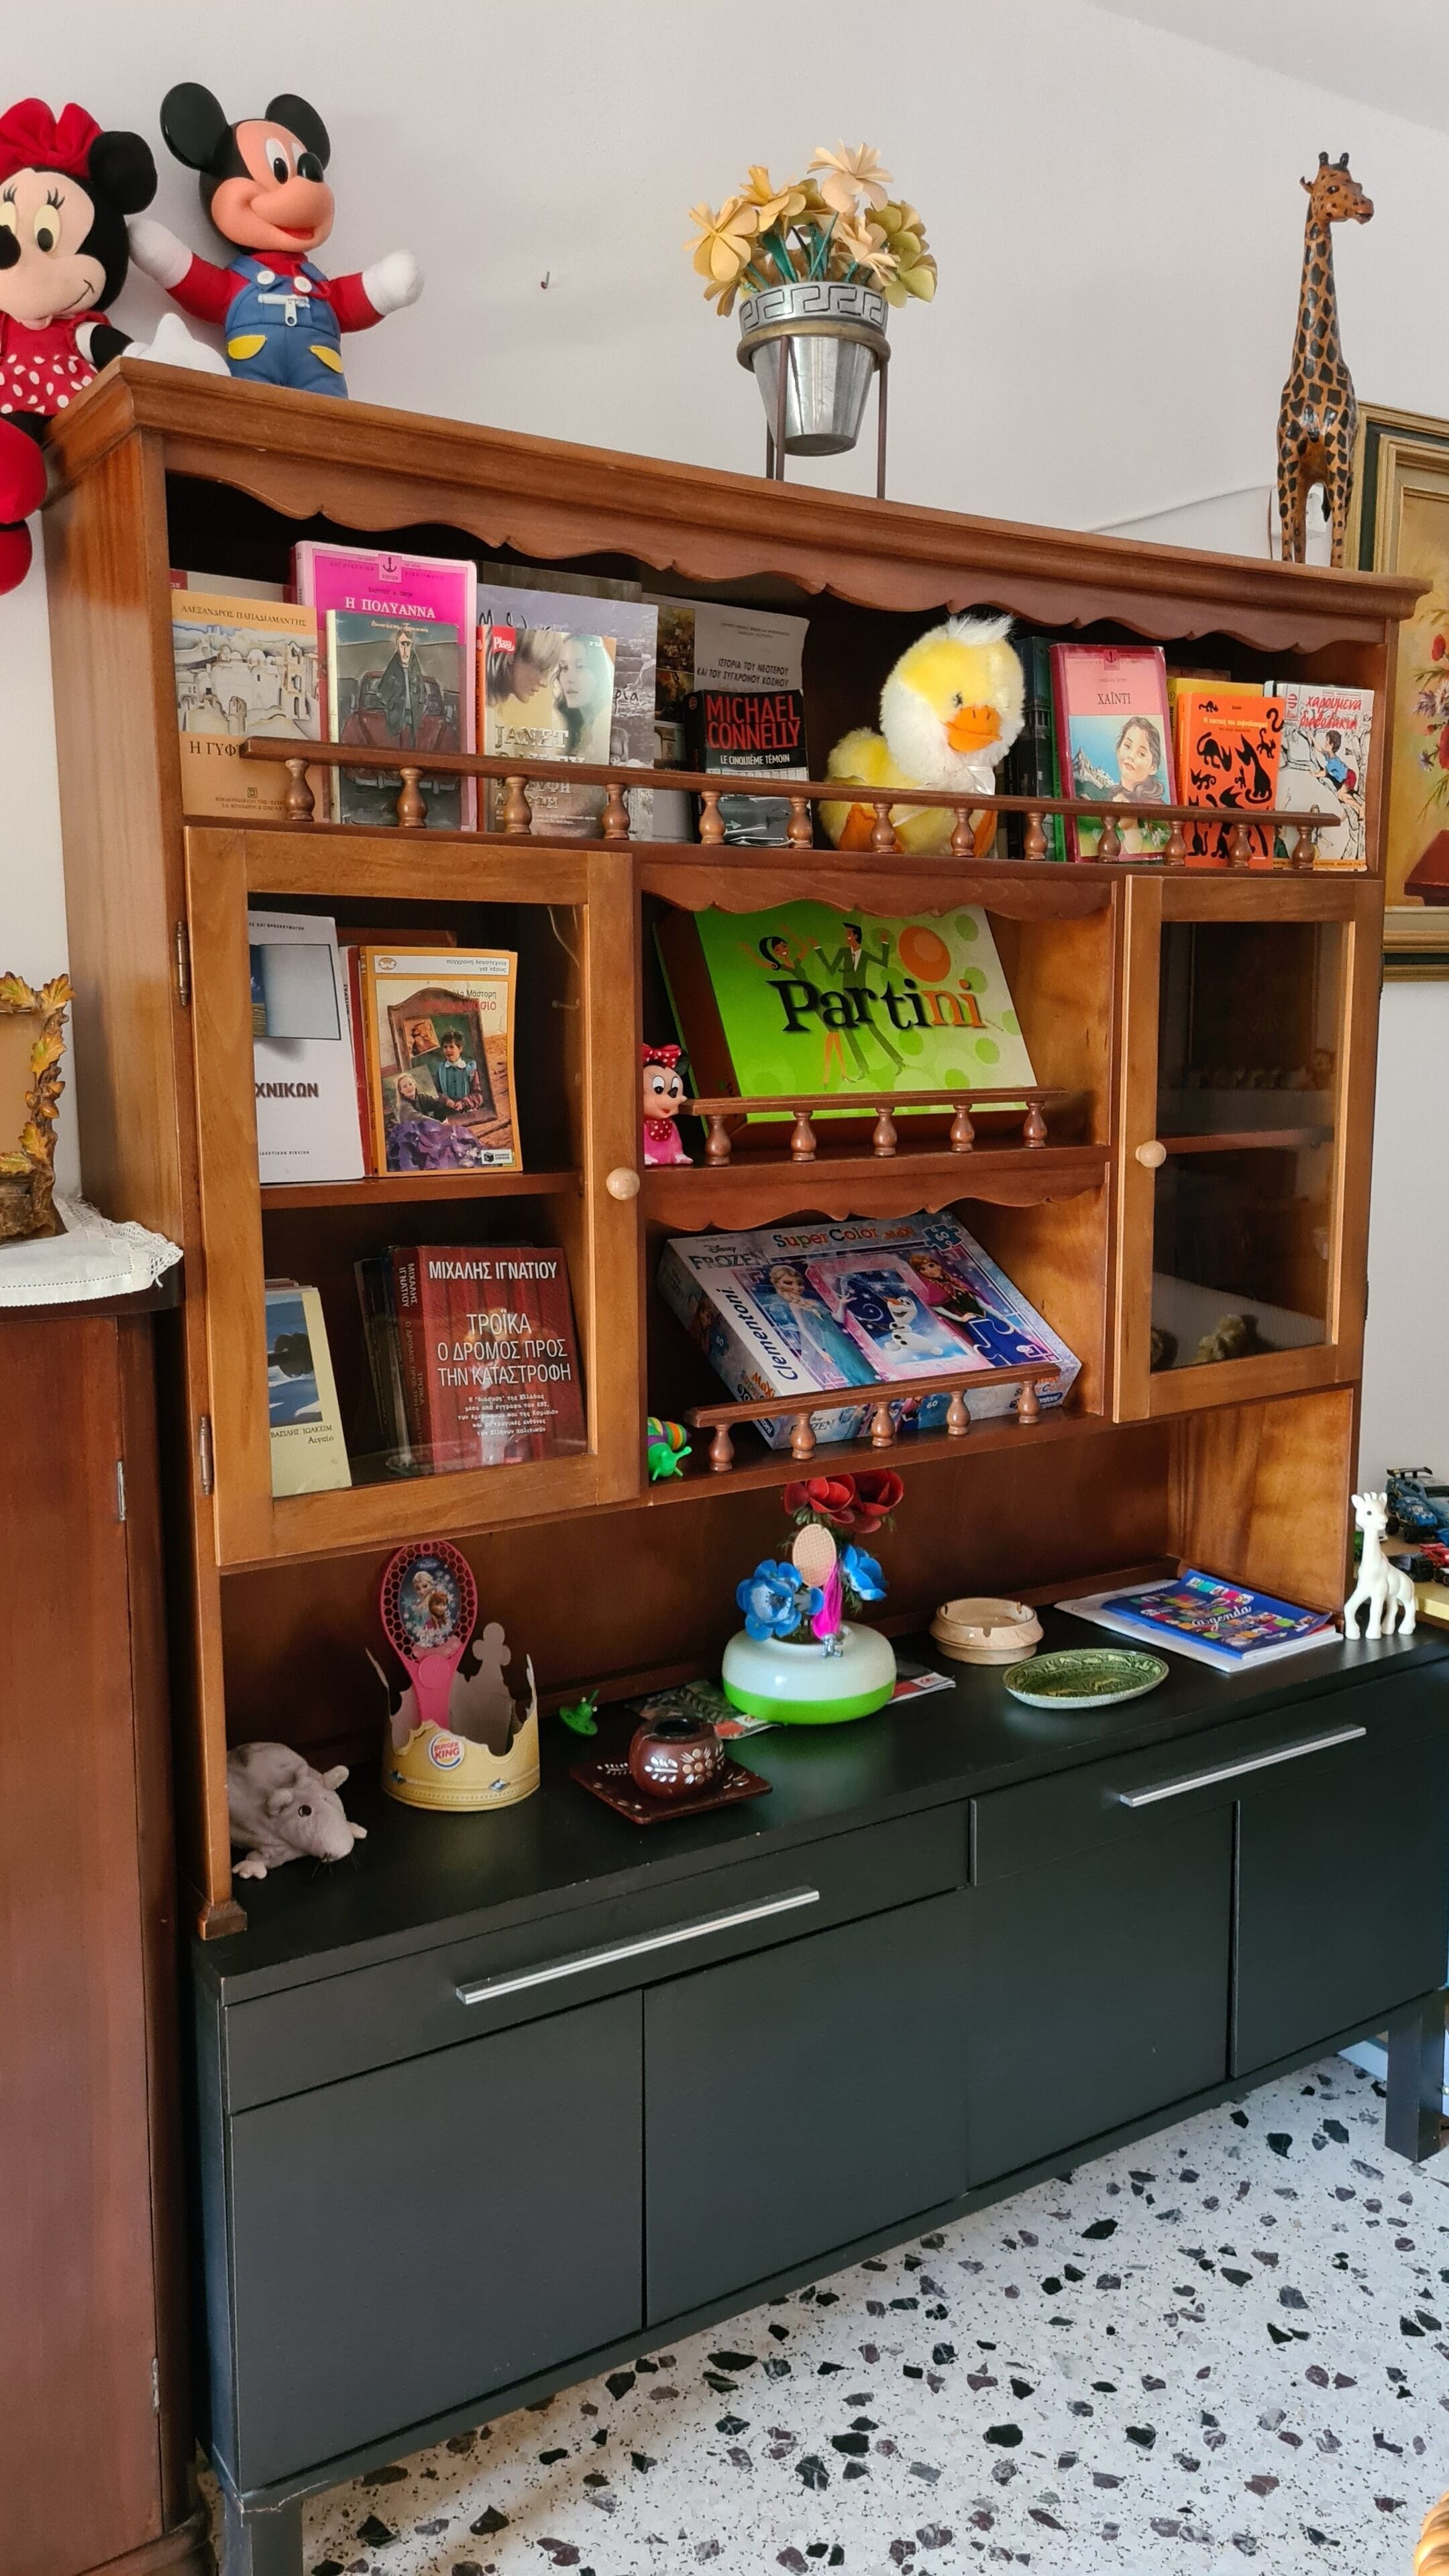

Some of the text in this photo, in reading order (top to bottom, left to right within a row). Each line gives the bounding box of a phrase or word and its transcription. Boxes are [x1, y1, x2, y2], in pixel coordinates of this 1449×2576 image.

[181, 605, 307, 627] ΑΛΕΞΑΝΔΡΟΣ ΠΑΠΑΔΙΑΜΑΝΤΗΣ
[345, 596, 436, 619] Η ΠΟΛΥΑΝΝΑ
[493, 636, 515, 652] Plaza
[696, 667, 708, 677] ΚΑΙ
[709, 668, 721, 679] ΤΟΥ
[722, 670, 761, 684] ΣΥΓΧΡΟΝΟΥ
[761, 676, 790, 688] ΚΟΣΜΟΥ
[718, 658, 789, 676] ΙΣΤΟΡΙΑ ΤΟΥ ΝΕΟΤΕΡΟΥ
[705, 694, 801, 724] MICHAEL
[1097, 692, 1132, 705] ΧΑΪΝΤΙ
[494, 724, 570, 749] JANET
[706, 720, 801, 750] CONNELLY
[189, 741, 240, 757] Η ΓΥΦ
[720, 755, 728, 765] LE
[765, 753, 790, 765] TÉMOIN
[466, 989, 497, 999] Μάστορη
[765, 977, 987, 1032] Partini
[703, 1244, 737, 1254] Disney
[428, 1260, 557, 1280] ΜΙΧΑΛΗΣ ΙΓΝΑΤΙΟΥ
[688, 1249, 771, 1271] FROZEN
[398, 1267, 410, 1308] ΙΓΝΑΤΙΟΥ
[407, 1263, 418, 1305] ΜΙΧΑΛΗΣ
[466, 1308, 533, 1336] ΤΡΟΪΚΑ
[715, 1286, 799, 1382] Clementoni
[437, 1338, 568, 1361] Ο ΔΡΟΜΟΣ ΠΡΟΣ
[437, 1362, 572, 1387] ΤΗΝ ΚΑΤΑΣΤΡΟΦΗ
[926, 1400, 938, 1409] 60
[270, 1424, 333, 1438] ΒΑΣΙΛΗΣ ΙΩΑΚΕΙΜ
[308, 1434, 335, 1445] Αιγαίο
[435, 1747, 460, 1761] KING
